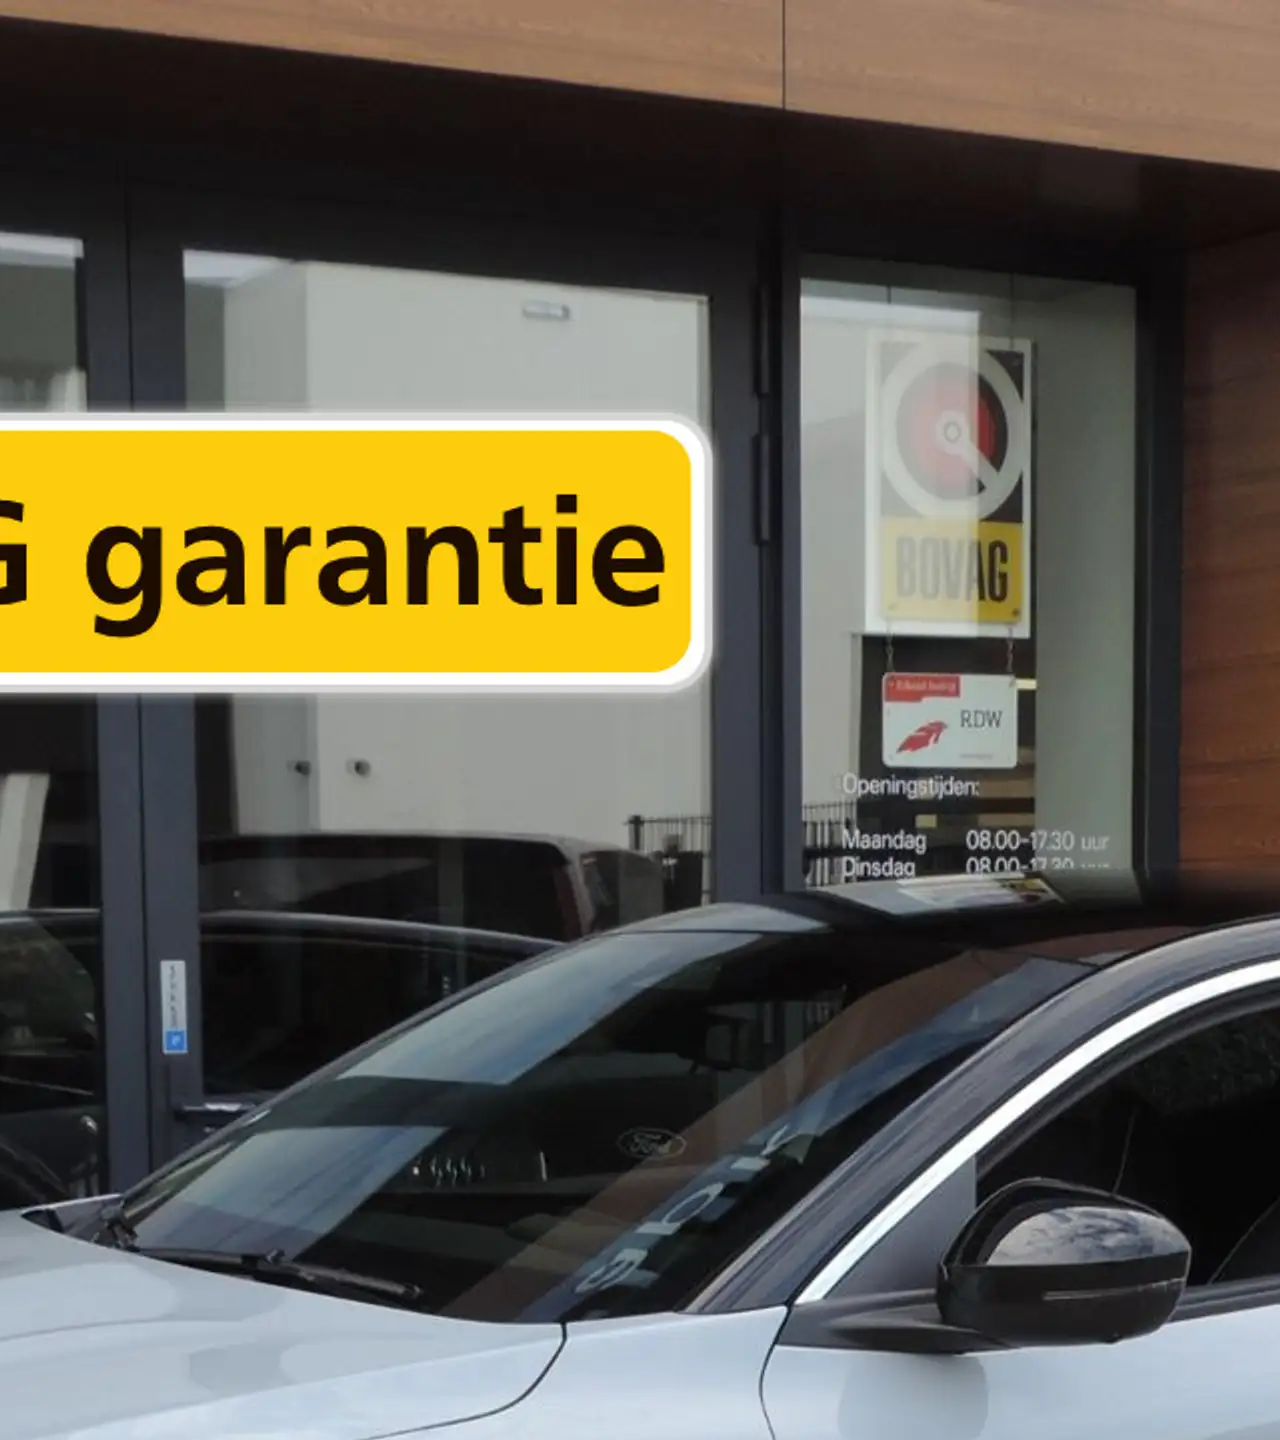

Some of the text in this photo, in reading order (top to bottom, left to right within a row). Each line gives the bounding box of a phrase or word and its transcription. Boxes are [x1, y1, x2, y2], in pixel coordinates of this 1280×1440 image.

[895, 534, 1010, 605] BOVAG
[959, 709, 1004, 729] RDW
[841, 772, 981, 800] Openingstijden:
[841, 829, 1111, 855] Maandag 08.00-17.30 uur
[841, 856, 916, 878] Dinsdag
